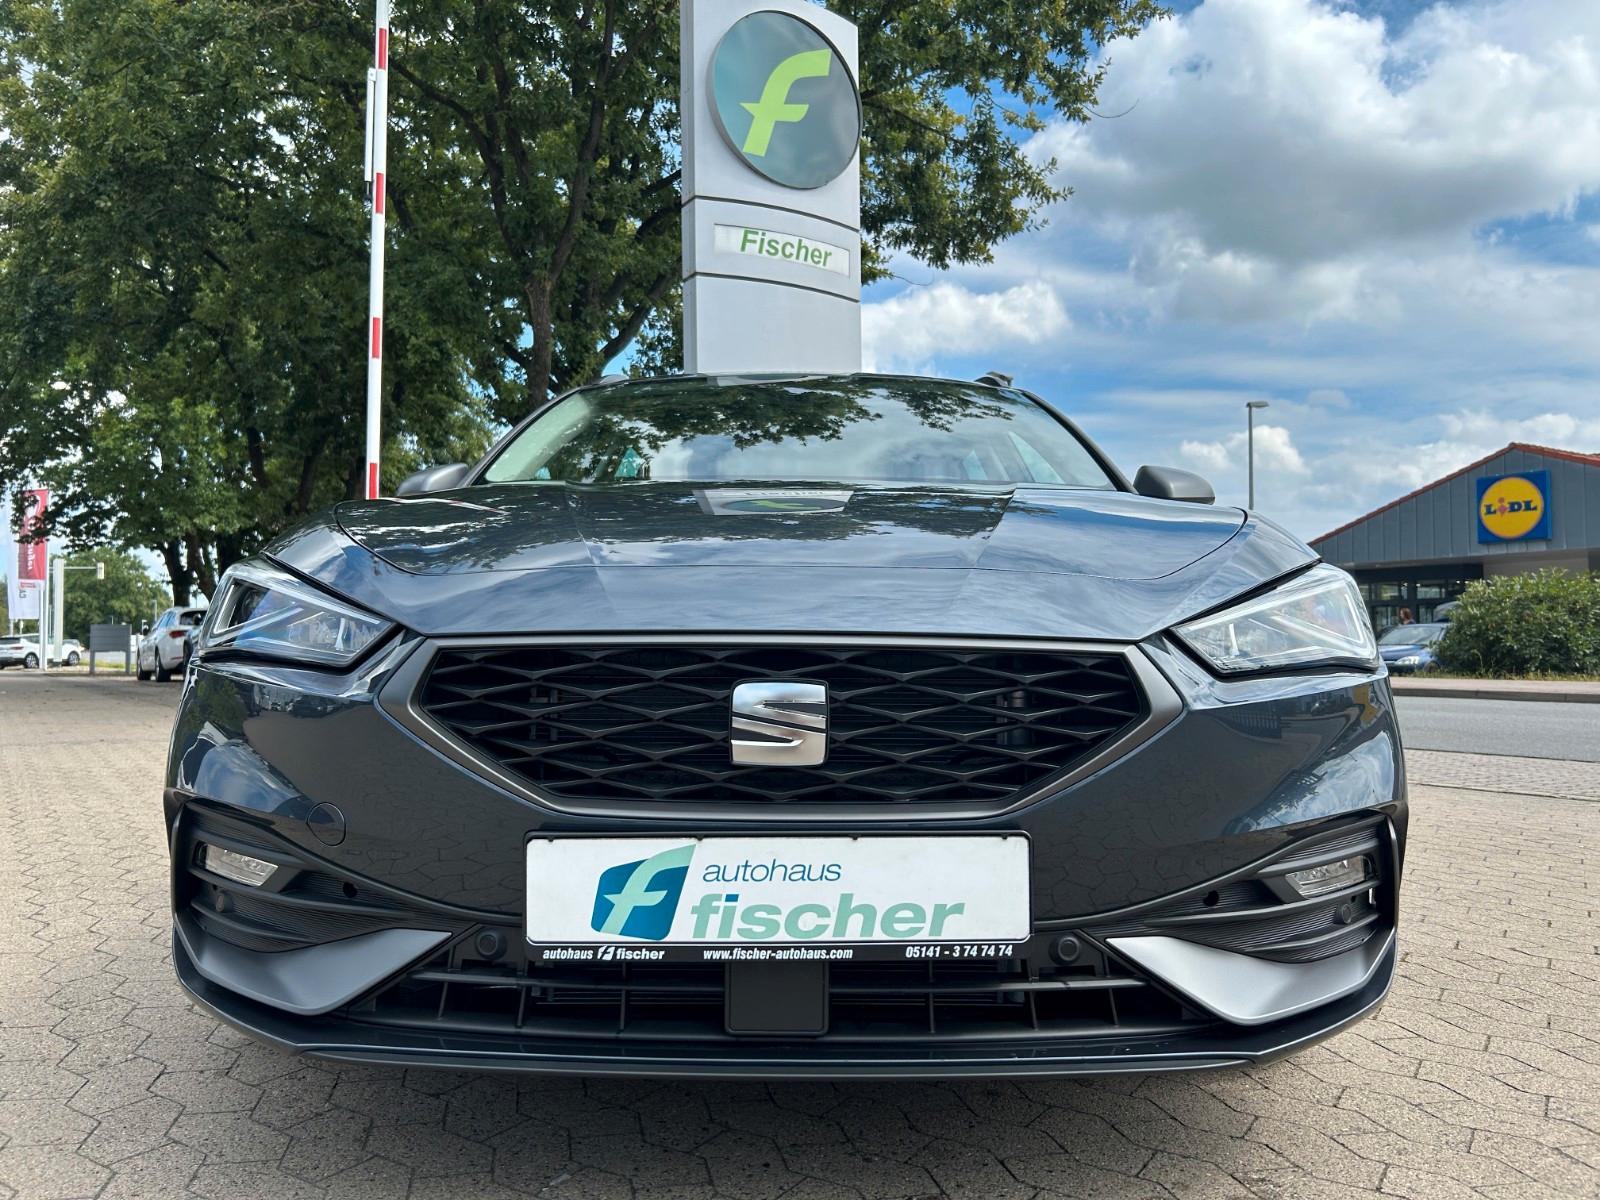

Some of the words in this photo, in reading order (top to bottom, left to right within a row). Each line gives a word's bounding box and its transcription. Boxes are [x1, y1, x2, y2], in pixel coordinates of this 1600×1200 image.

[740, 227, 832, 268] Fischer
[702, 858, 842, 883] autohaus
[690, 892, 966, 940] fischer
[542, 947, 594, 960] autohaus
[616, 947, 665, 960] fischer
[703, 947, 854, 961] www.fischer-autohaus.com
[905, 945, 941, 958] 05141
